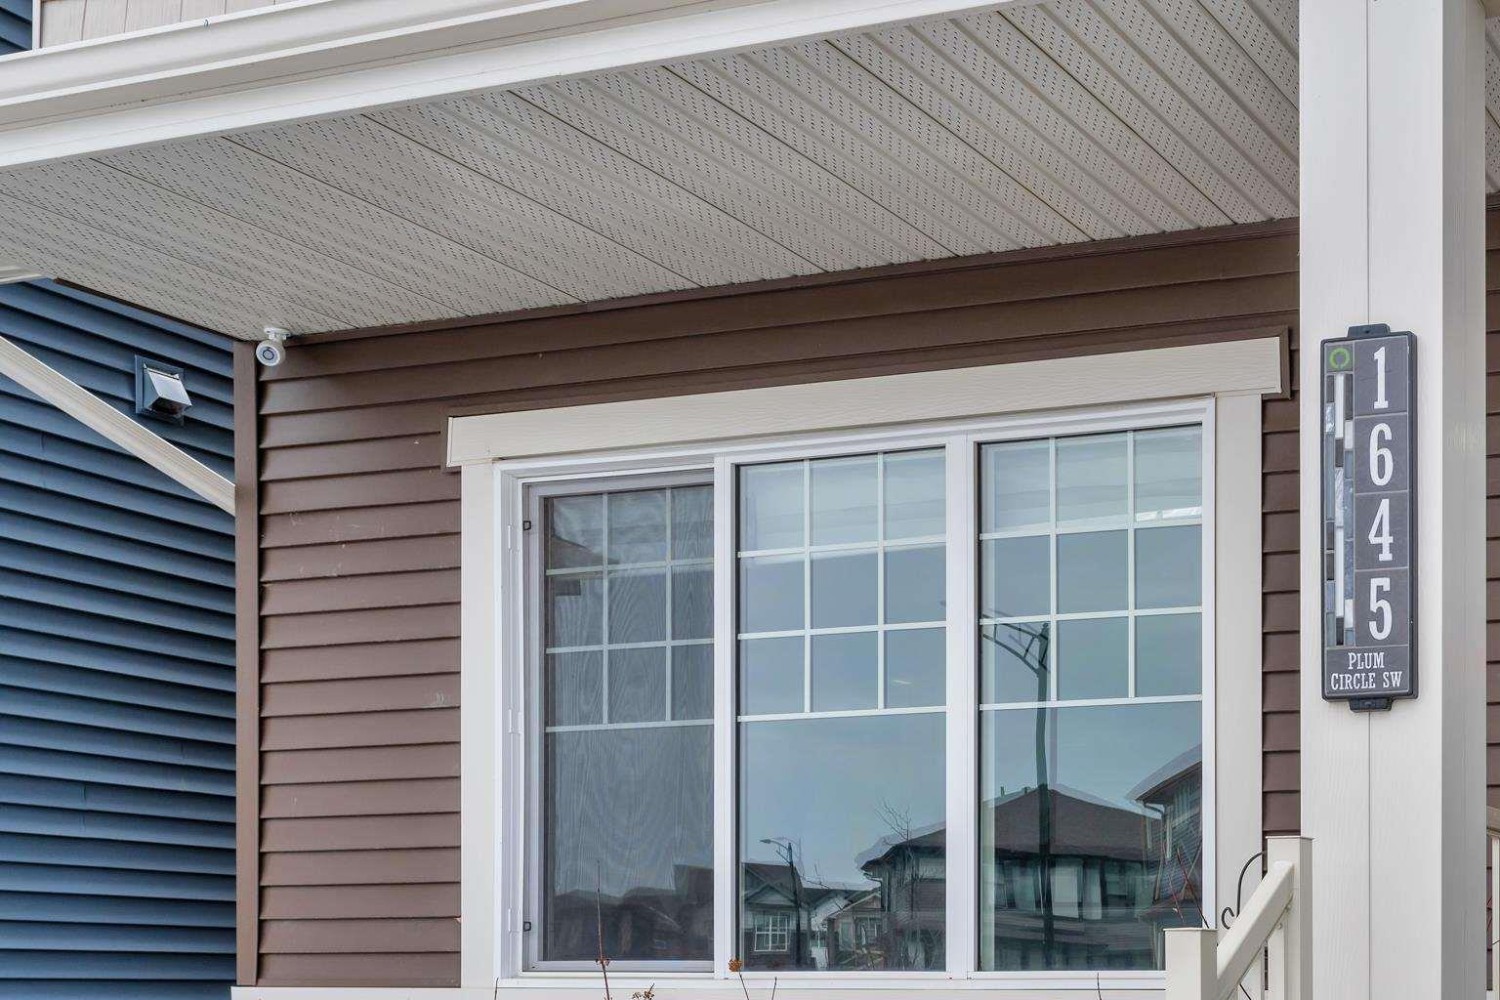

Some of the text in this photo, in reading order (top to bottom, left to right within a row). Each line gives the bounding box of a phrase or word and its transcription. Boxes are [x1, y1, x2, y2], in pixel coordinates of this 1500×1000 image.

[1367, 346, 1394, 641] 1645
[1347, 652, 1385, 670] PLUM
[1330, 671, 1402, 690] CIRCLE SW
